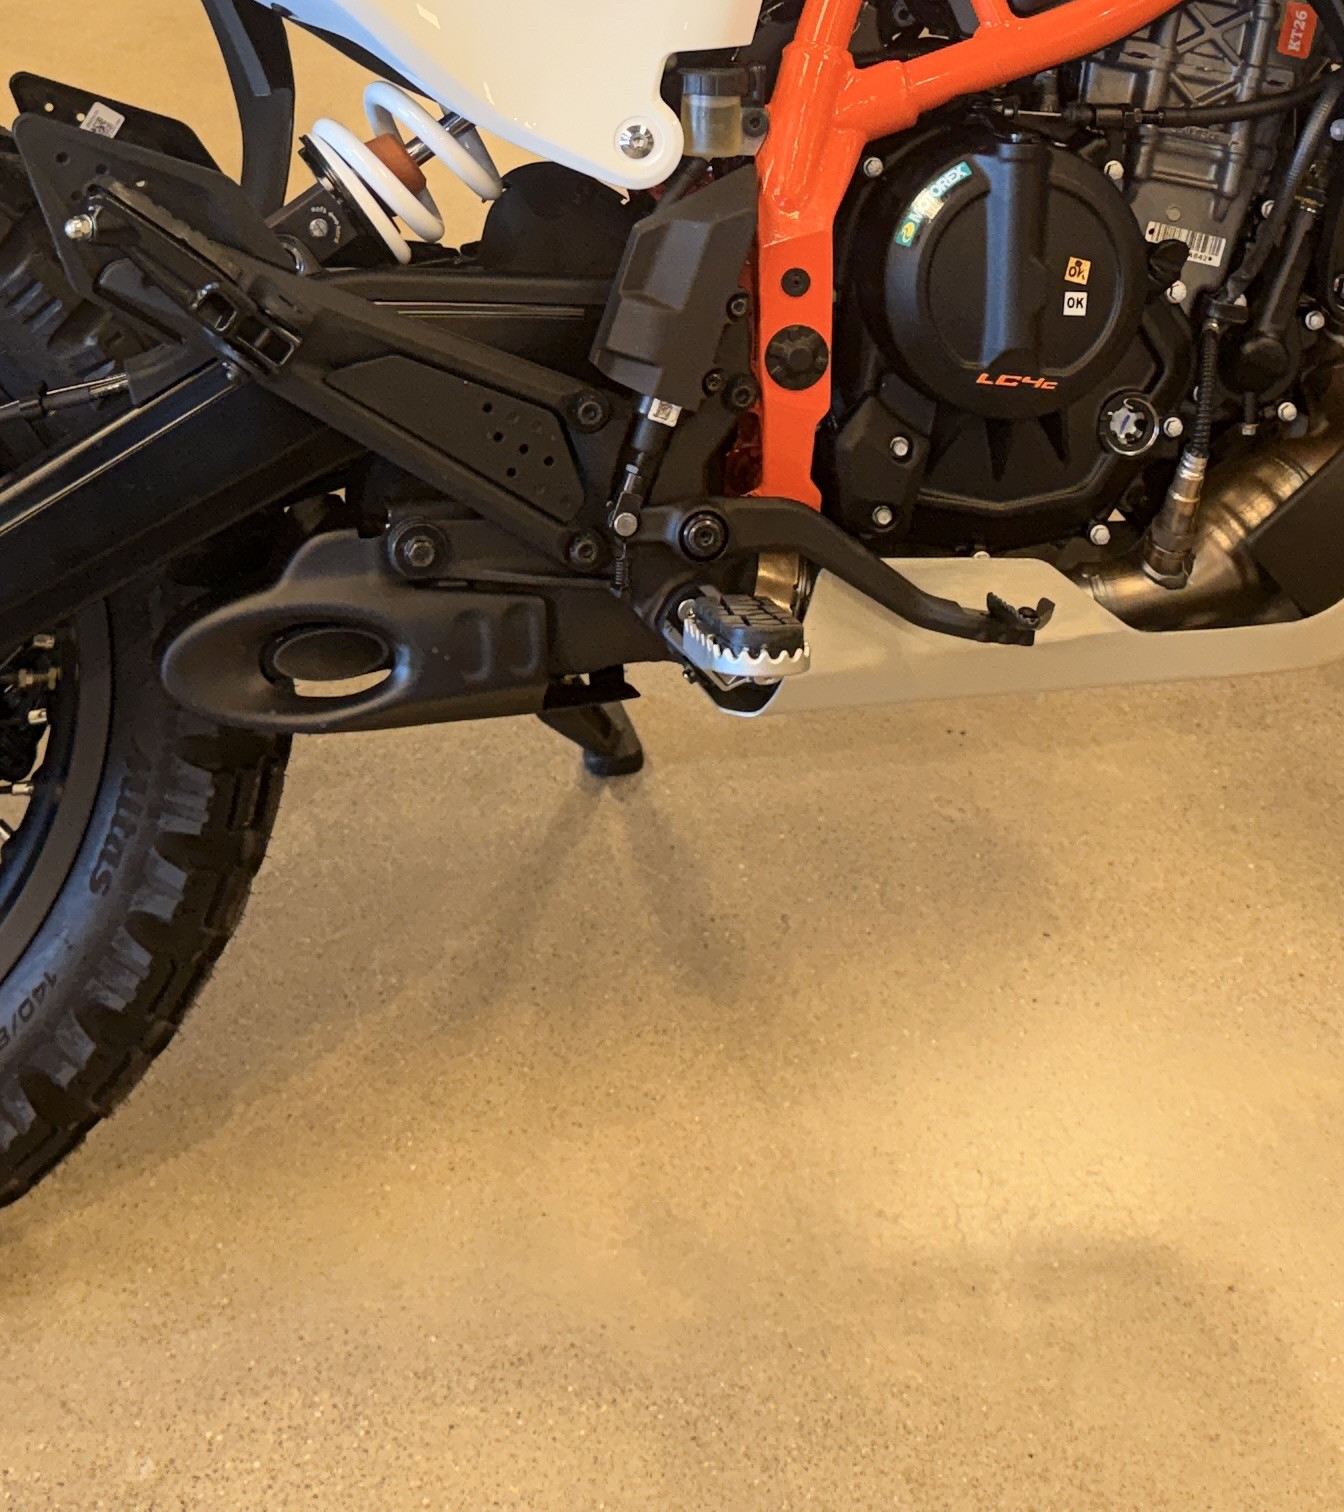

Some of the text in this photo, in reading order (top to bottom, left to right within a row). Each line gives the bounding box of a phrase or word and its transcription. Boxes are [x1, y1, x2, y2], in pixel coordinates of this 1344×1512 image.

[1287, 9, 1309, 52] KT26
[908, 163, 972, 224] MOTOREX
[1066, 296, 1085, 309] OK
